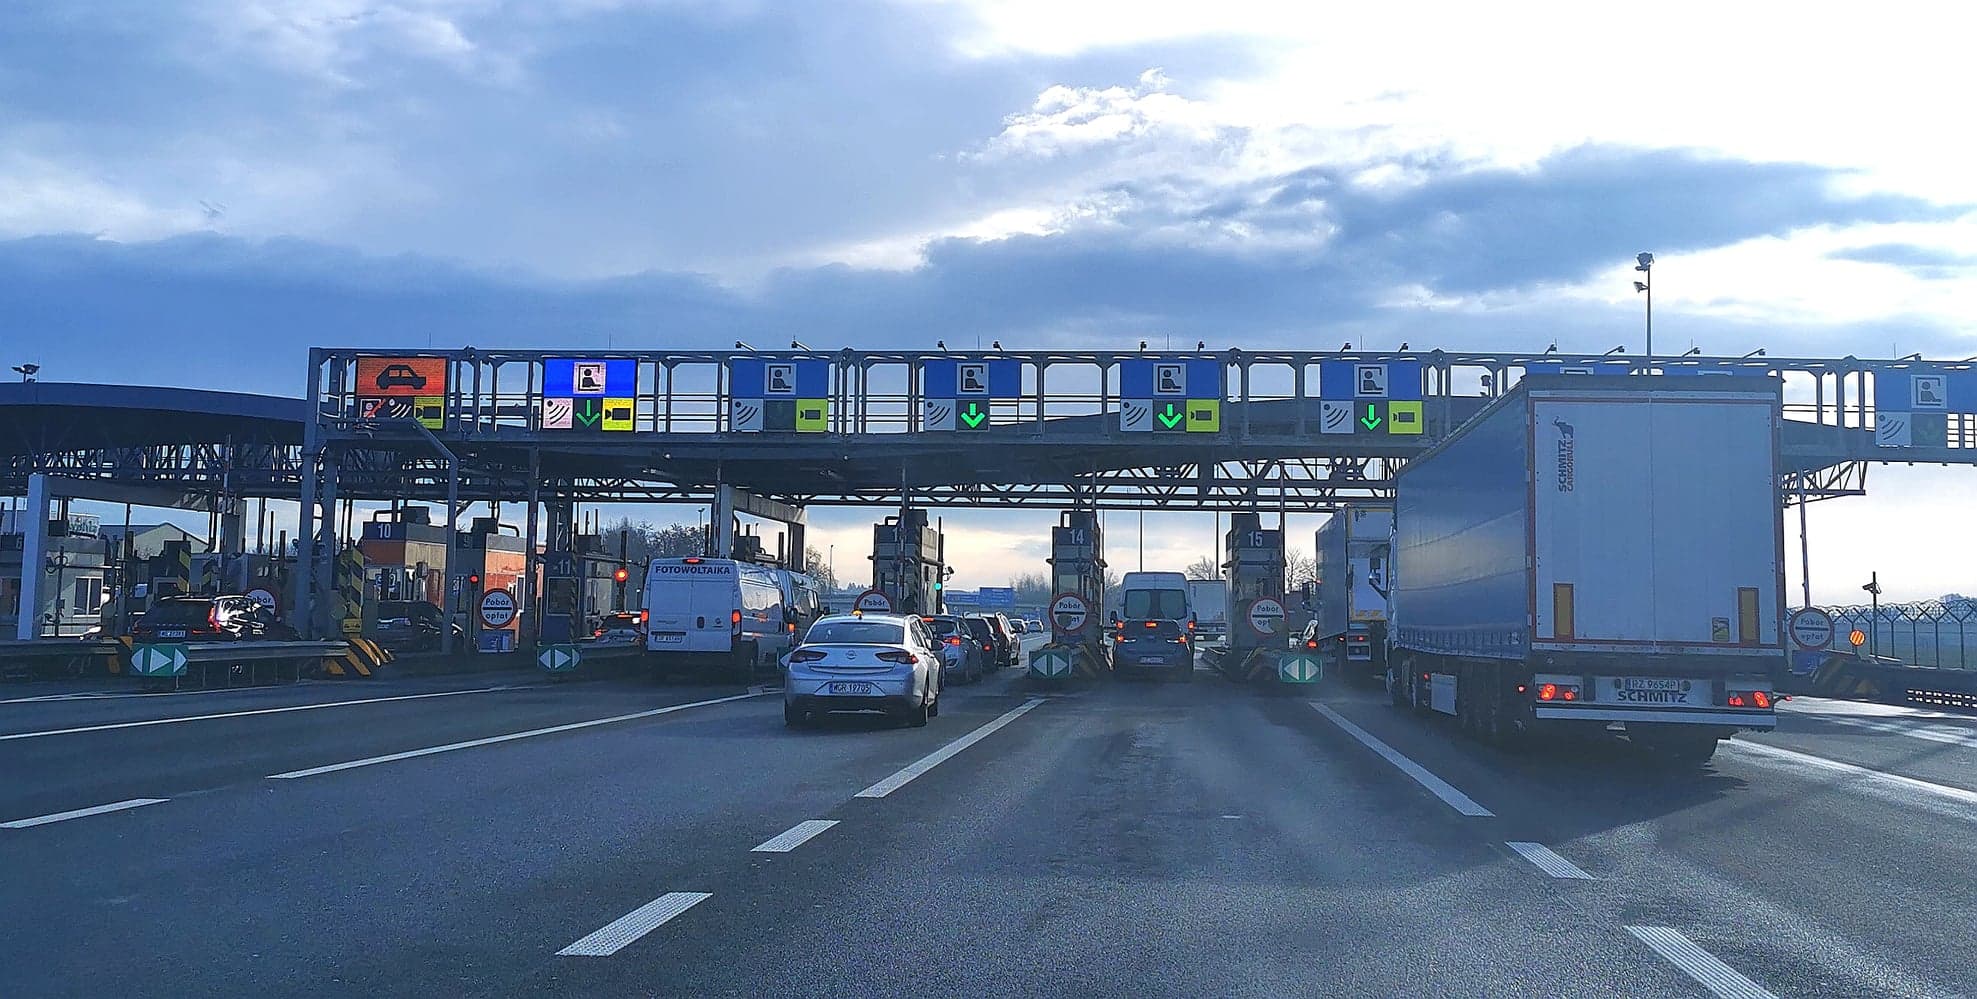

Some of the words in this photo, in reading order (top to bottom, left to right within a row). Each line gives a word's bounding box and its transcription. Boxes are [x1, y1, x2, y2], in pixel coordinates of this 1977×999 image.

[1558, 439, 1567, 492] SCHMITZ
[378, 523, 391, 538] 10
[1070, 529, 1084, 544] 14
[1248, 531, 1263, 547] 15
[558, 559, 570, 574] 11
[655, 566, 730, 574] FOTOWOLTAIKA
[1632, 680, 1645, 689] RZ
[1618, 690, 1687, 703] SCHMITZ
